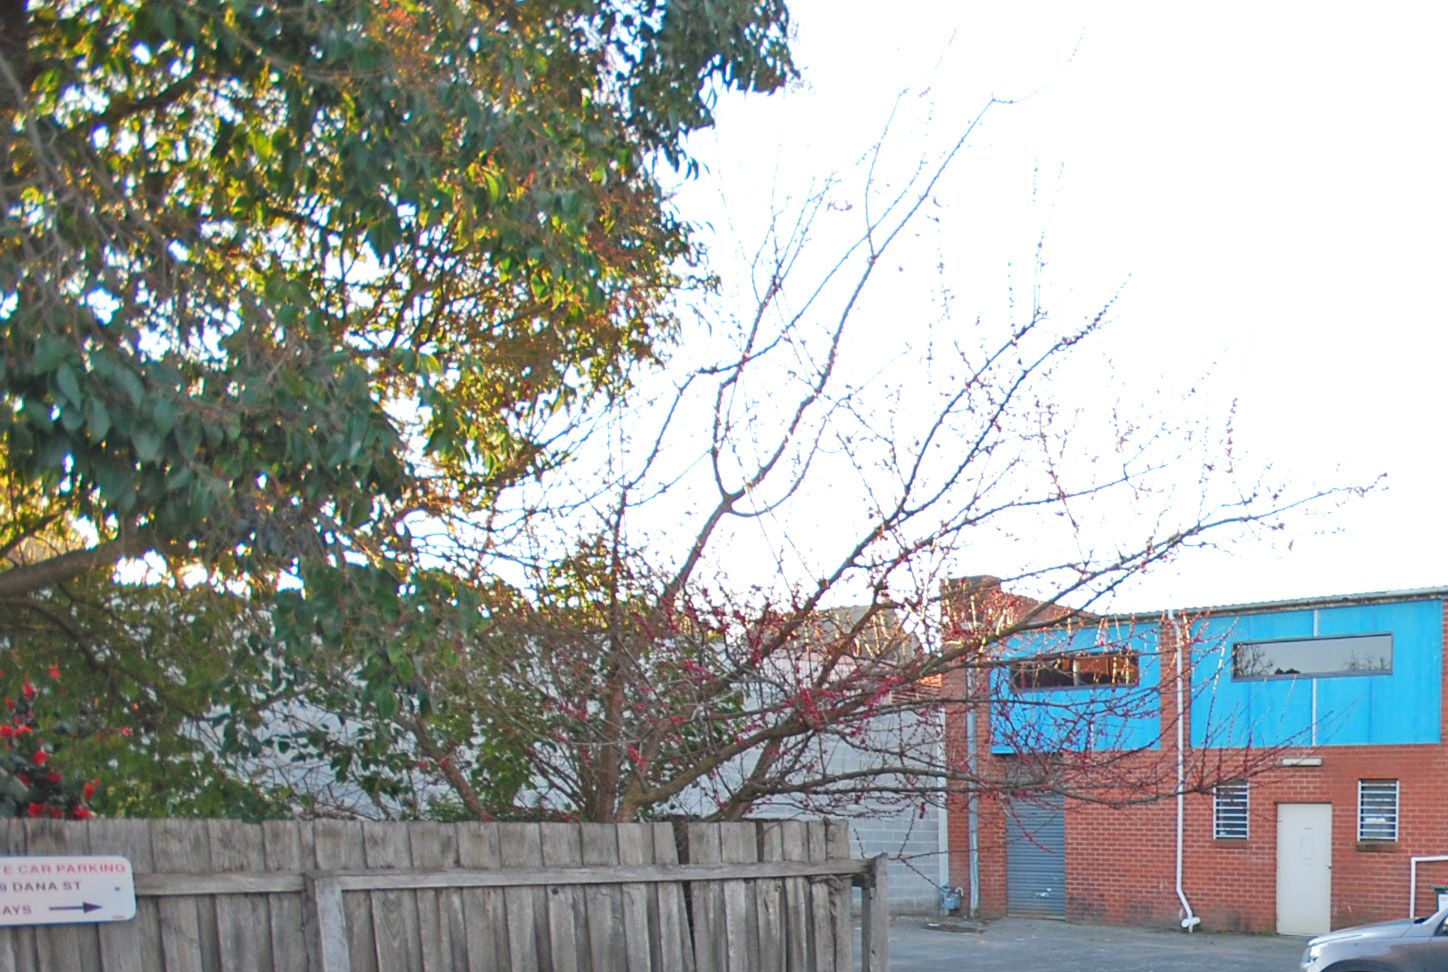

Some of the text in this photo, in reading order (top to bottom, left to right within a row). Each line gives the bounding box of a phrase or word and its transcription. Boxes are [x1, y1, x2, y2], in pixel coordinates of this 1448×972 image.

[18, 864, 52, 875] CAR
[56, 862, 127, 874] PARKING
[12, 882, 58, 892] DANA
[63, 881, 81, 891] ST
